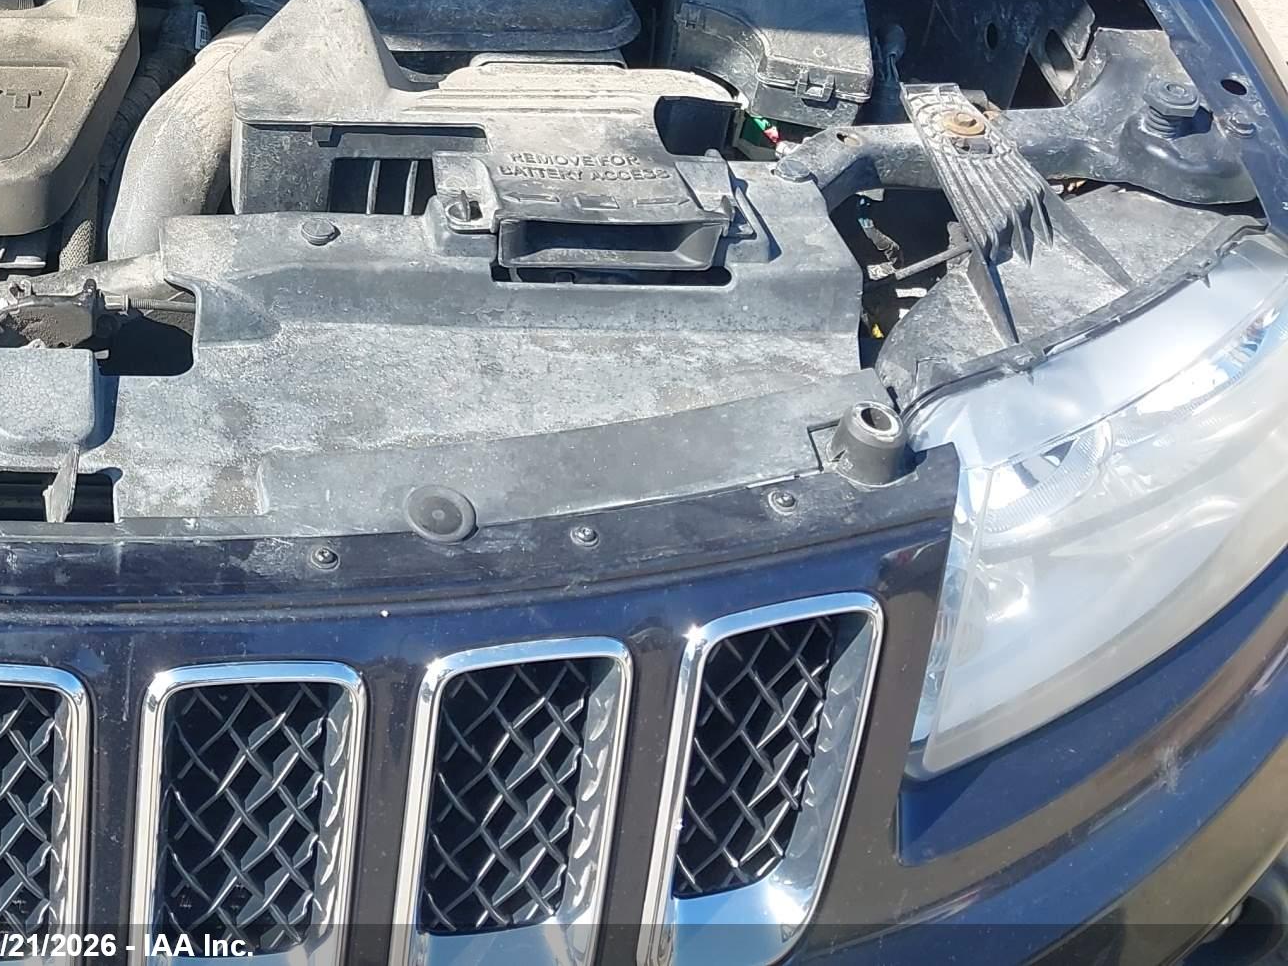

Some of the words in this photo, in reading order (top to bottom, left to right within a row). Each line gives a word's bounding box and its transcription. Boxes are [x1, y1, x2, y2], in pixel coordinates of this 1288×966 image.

[511, 152, 598, 168] REMOVE
[599, 153, 641, 167] FOR
[498, 165, 583, 181] BATTERY
[590, 169, 672, 182] ACCESS
